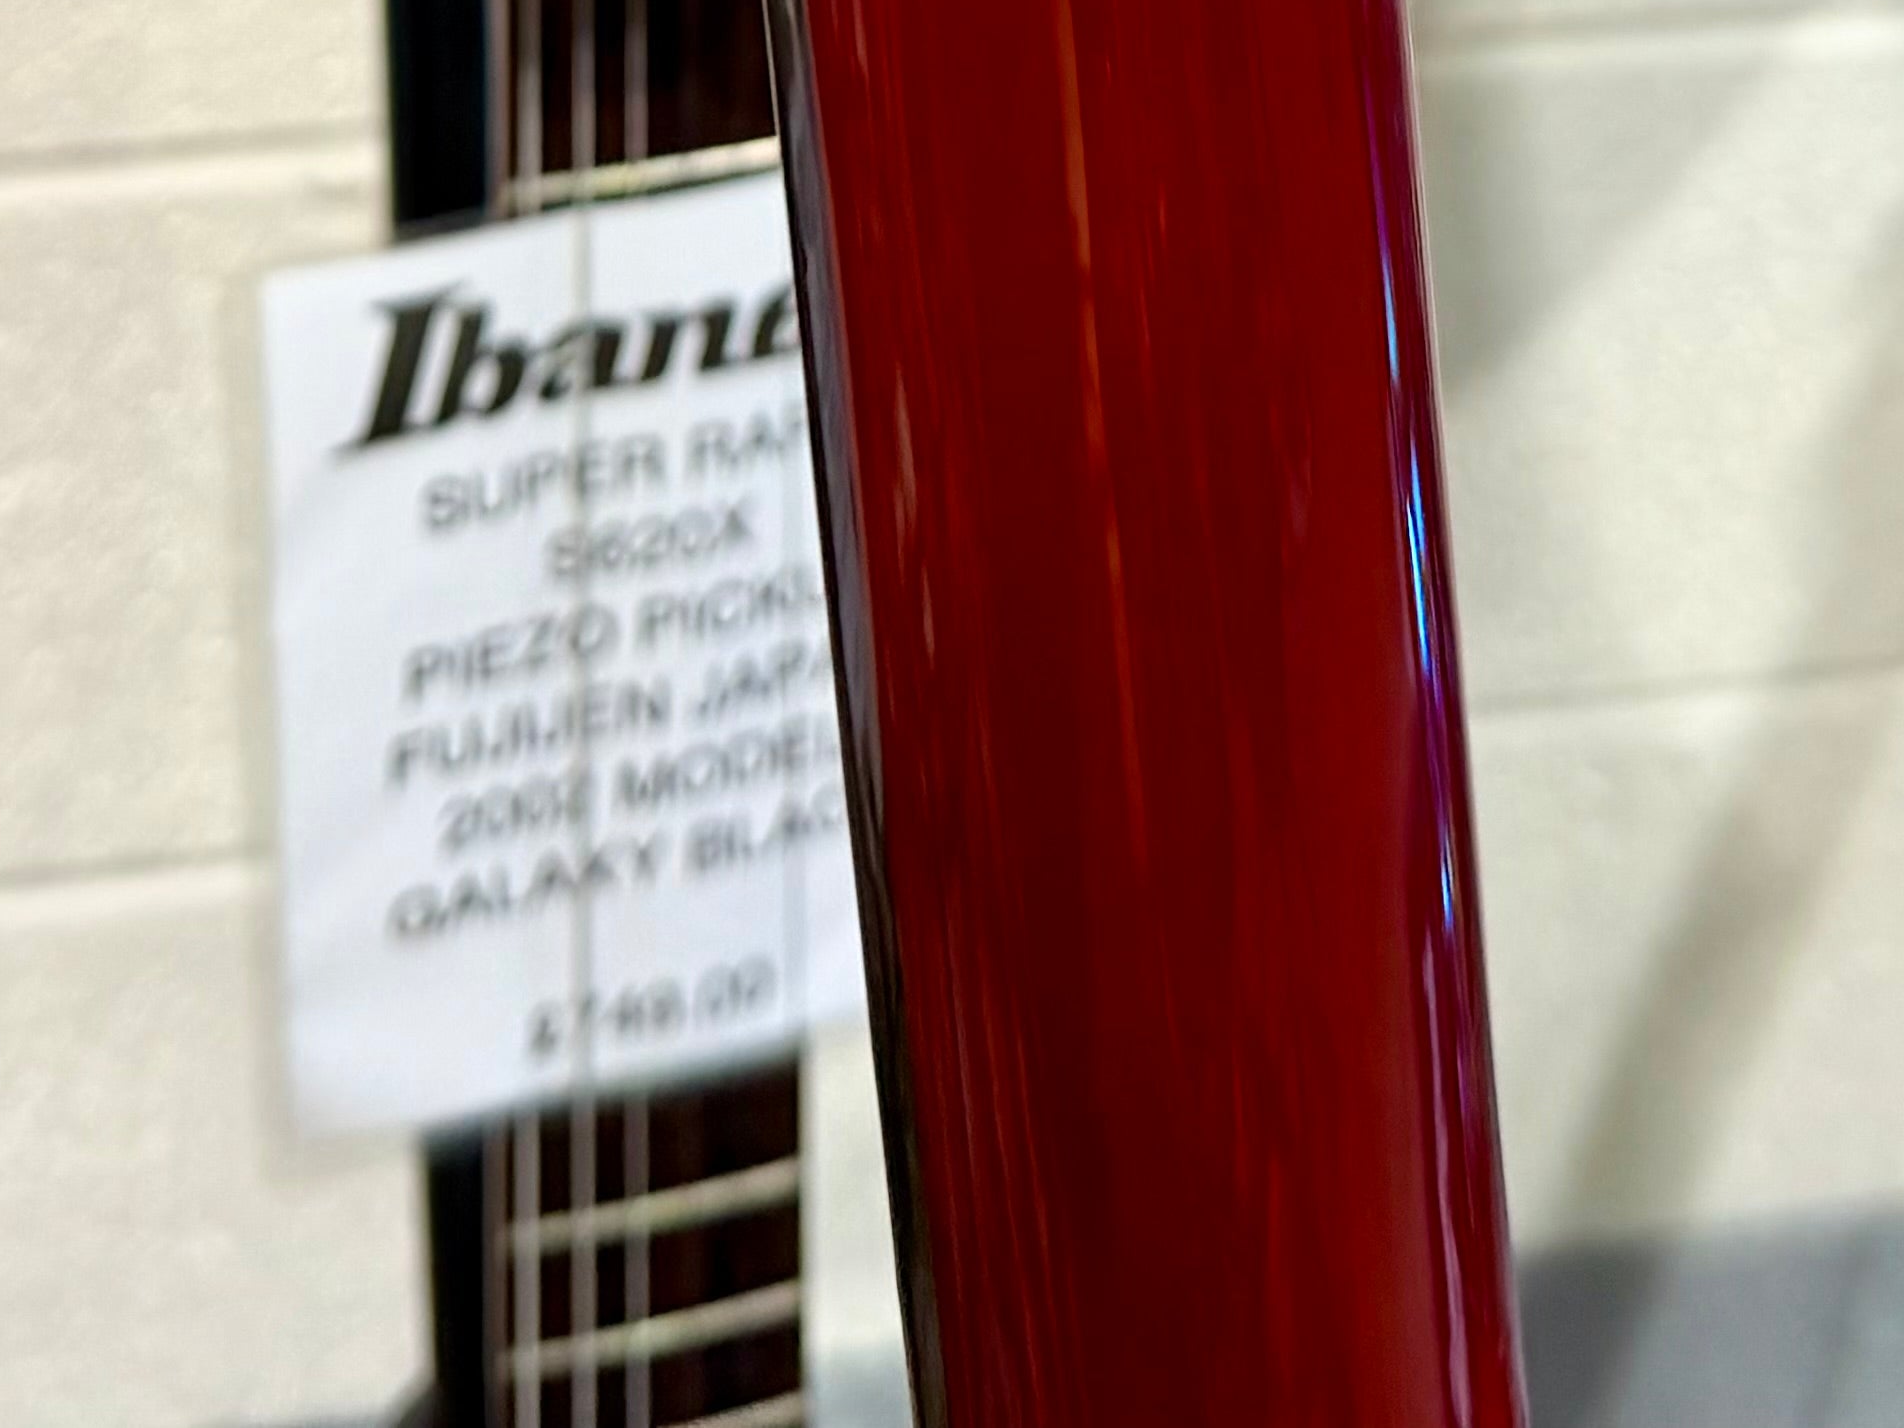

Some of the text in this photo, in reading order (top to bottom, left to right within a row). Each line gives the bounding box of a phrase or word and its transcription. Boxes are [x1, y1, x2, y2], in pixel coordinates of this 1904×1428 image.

[418, 432, 666, 532] SUPER
[402, 601, 618, 704] PIEZO
[388, 832, 668, 941] GALAXY
